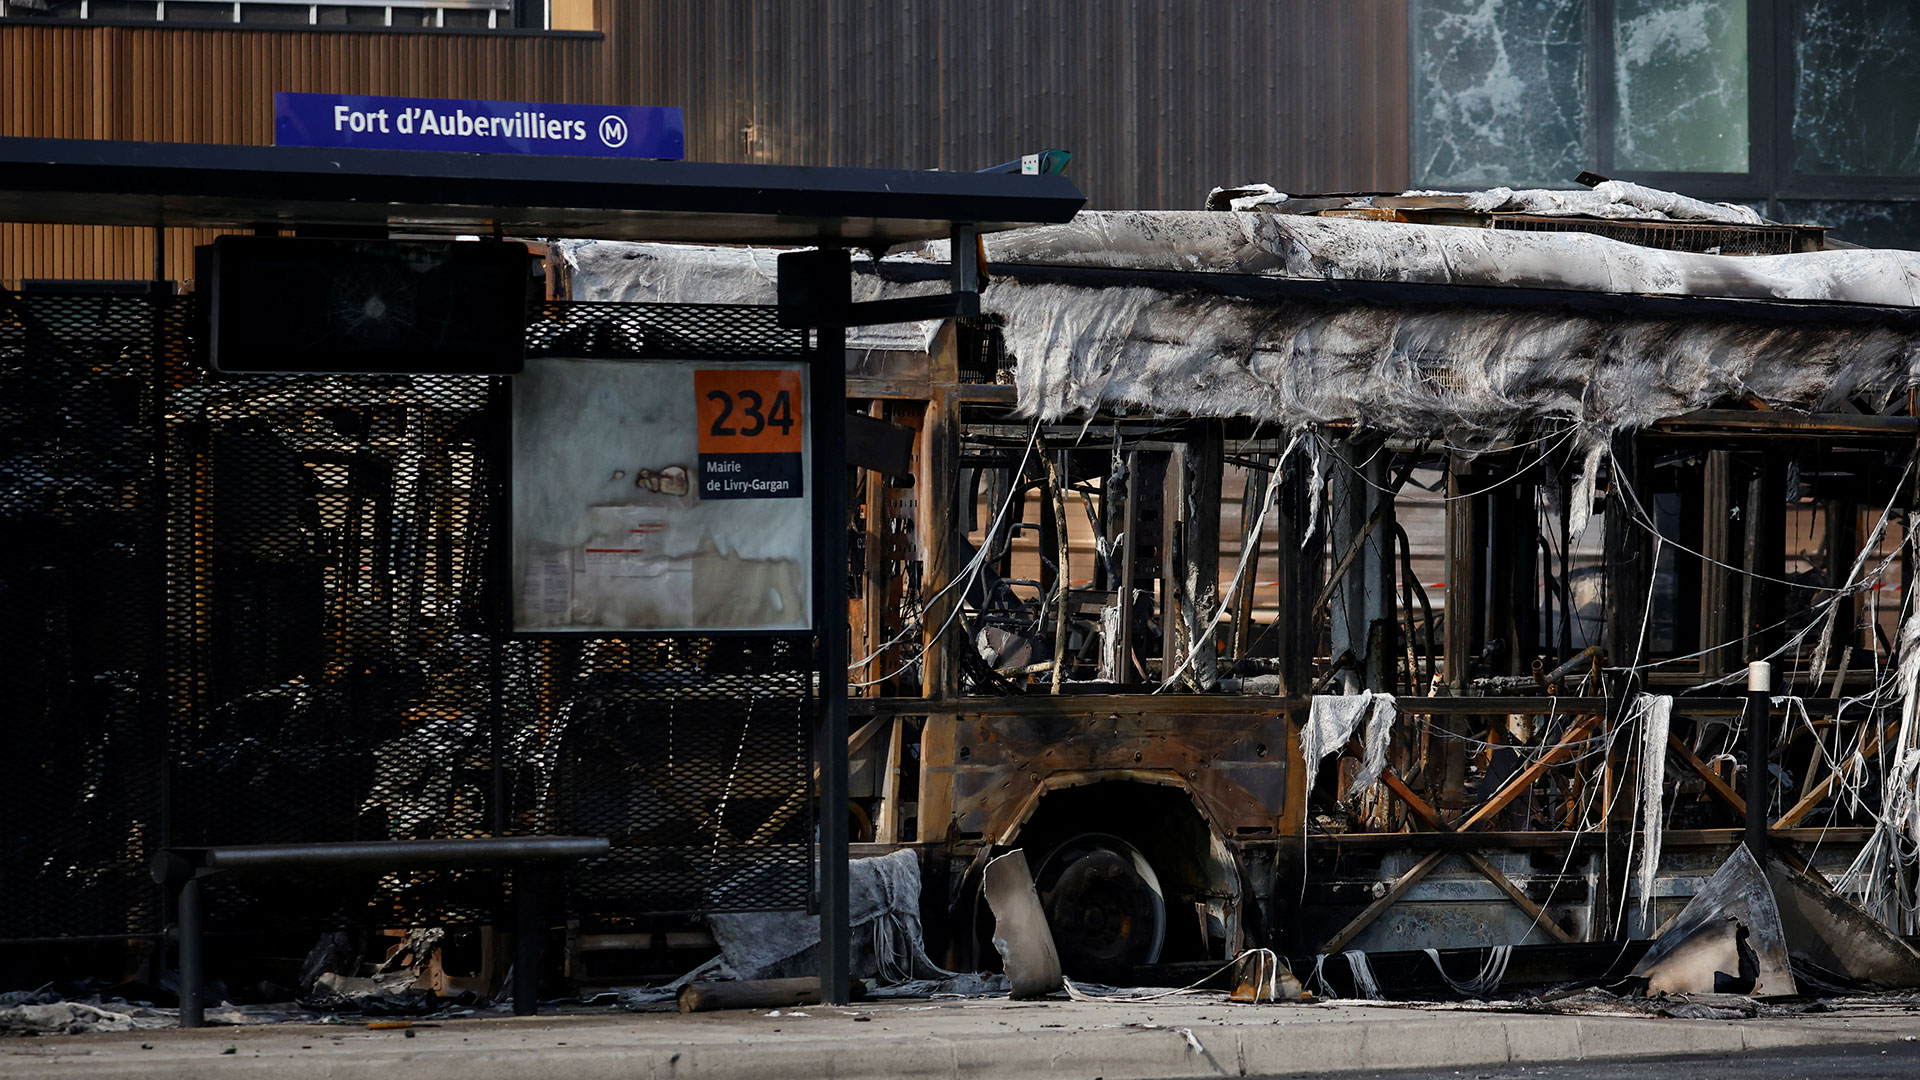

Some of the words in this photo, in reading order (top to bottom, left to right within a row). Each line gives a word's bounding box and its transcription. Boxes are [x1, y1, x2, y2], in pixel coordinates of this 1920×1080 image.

[334, 105, 390, 134] Fort
[396, 107, 587, 141] d'Aubervilliers
[706, 389, 795, 437] 234
[706, 460, 741, 473] Mairie
[706, 479, 721, 491] de
[724, 479, 789, 493] Livry-Gargan
